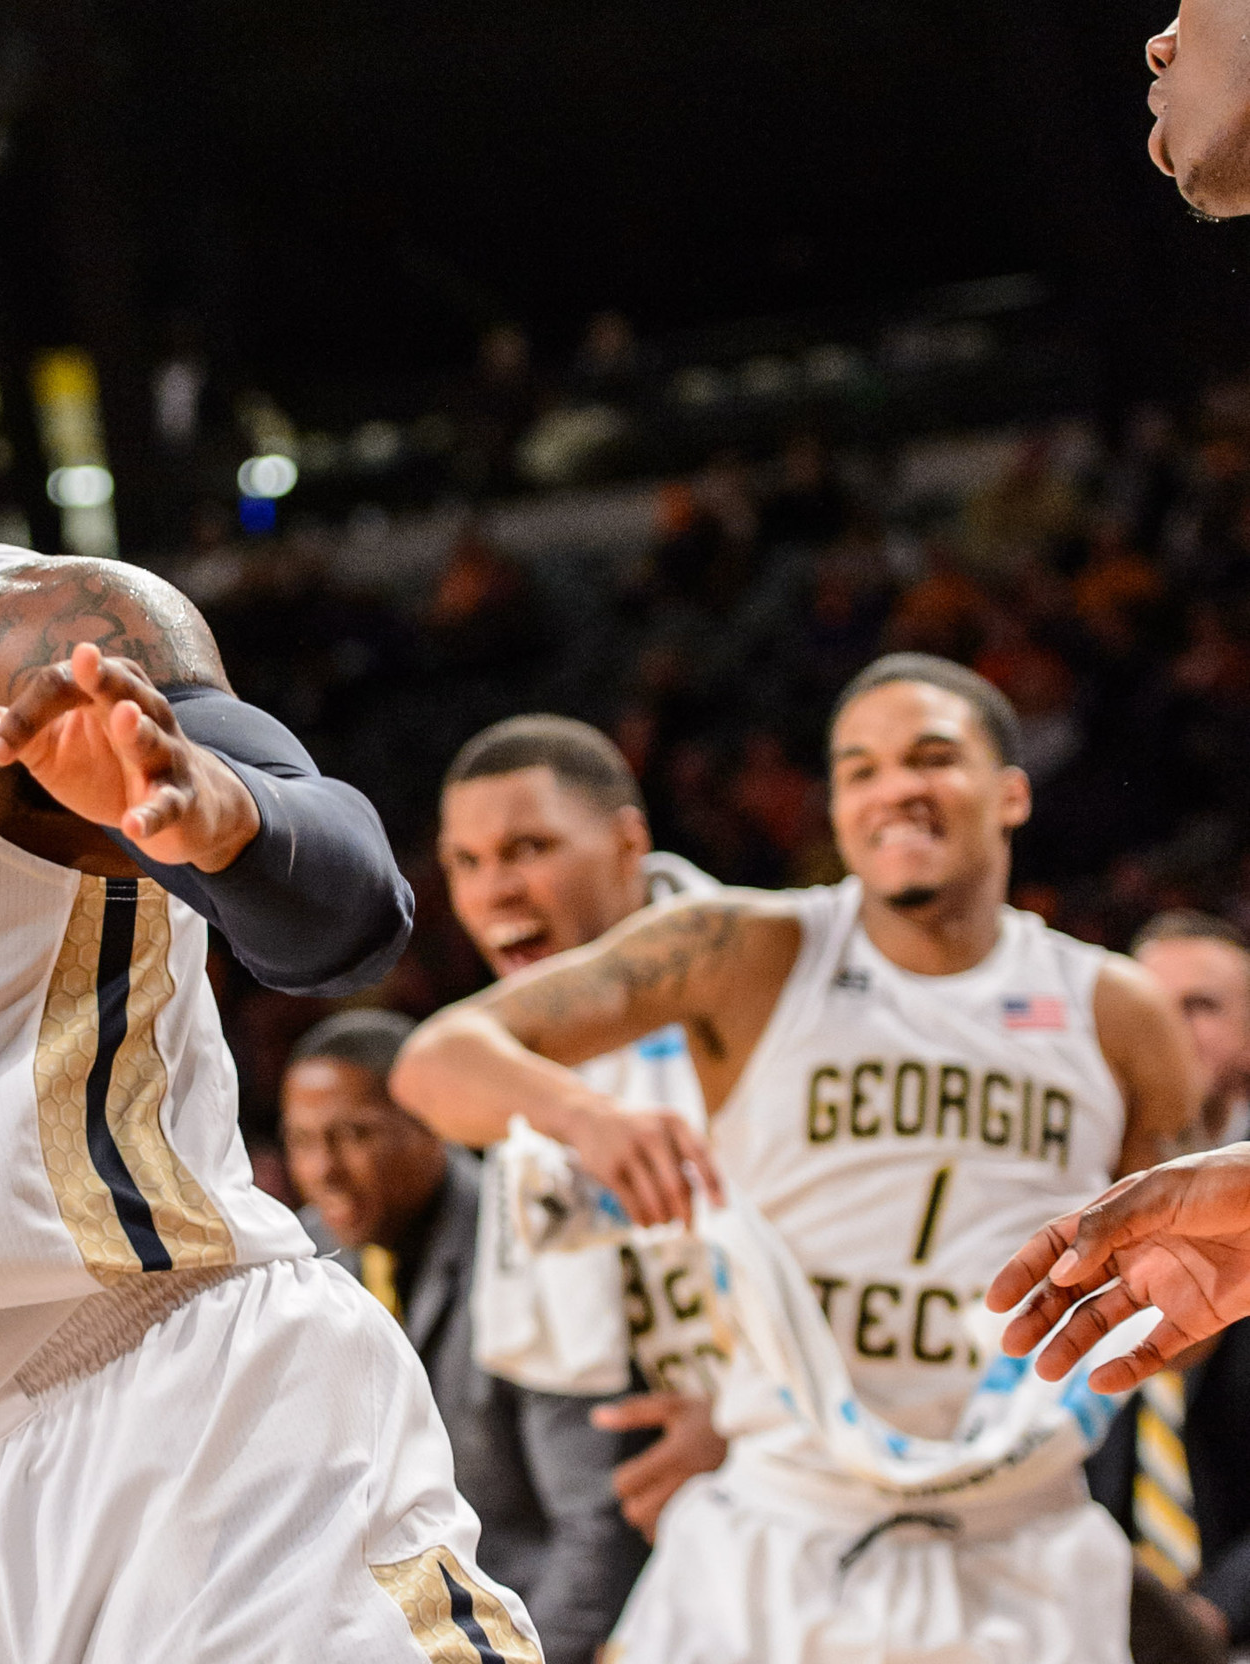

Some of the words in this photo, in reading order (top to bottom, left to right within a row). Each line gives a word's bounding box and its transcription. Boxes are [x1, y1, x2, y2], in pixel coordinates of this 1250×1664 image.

[807, 1060, 1074, 1169] GEORGIA
[910, 1160, 956, 1266] 1
[808, 1274, 982, 1369] TEC
